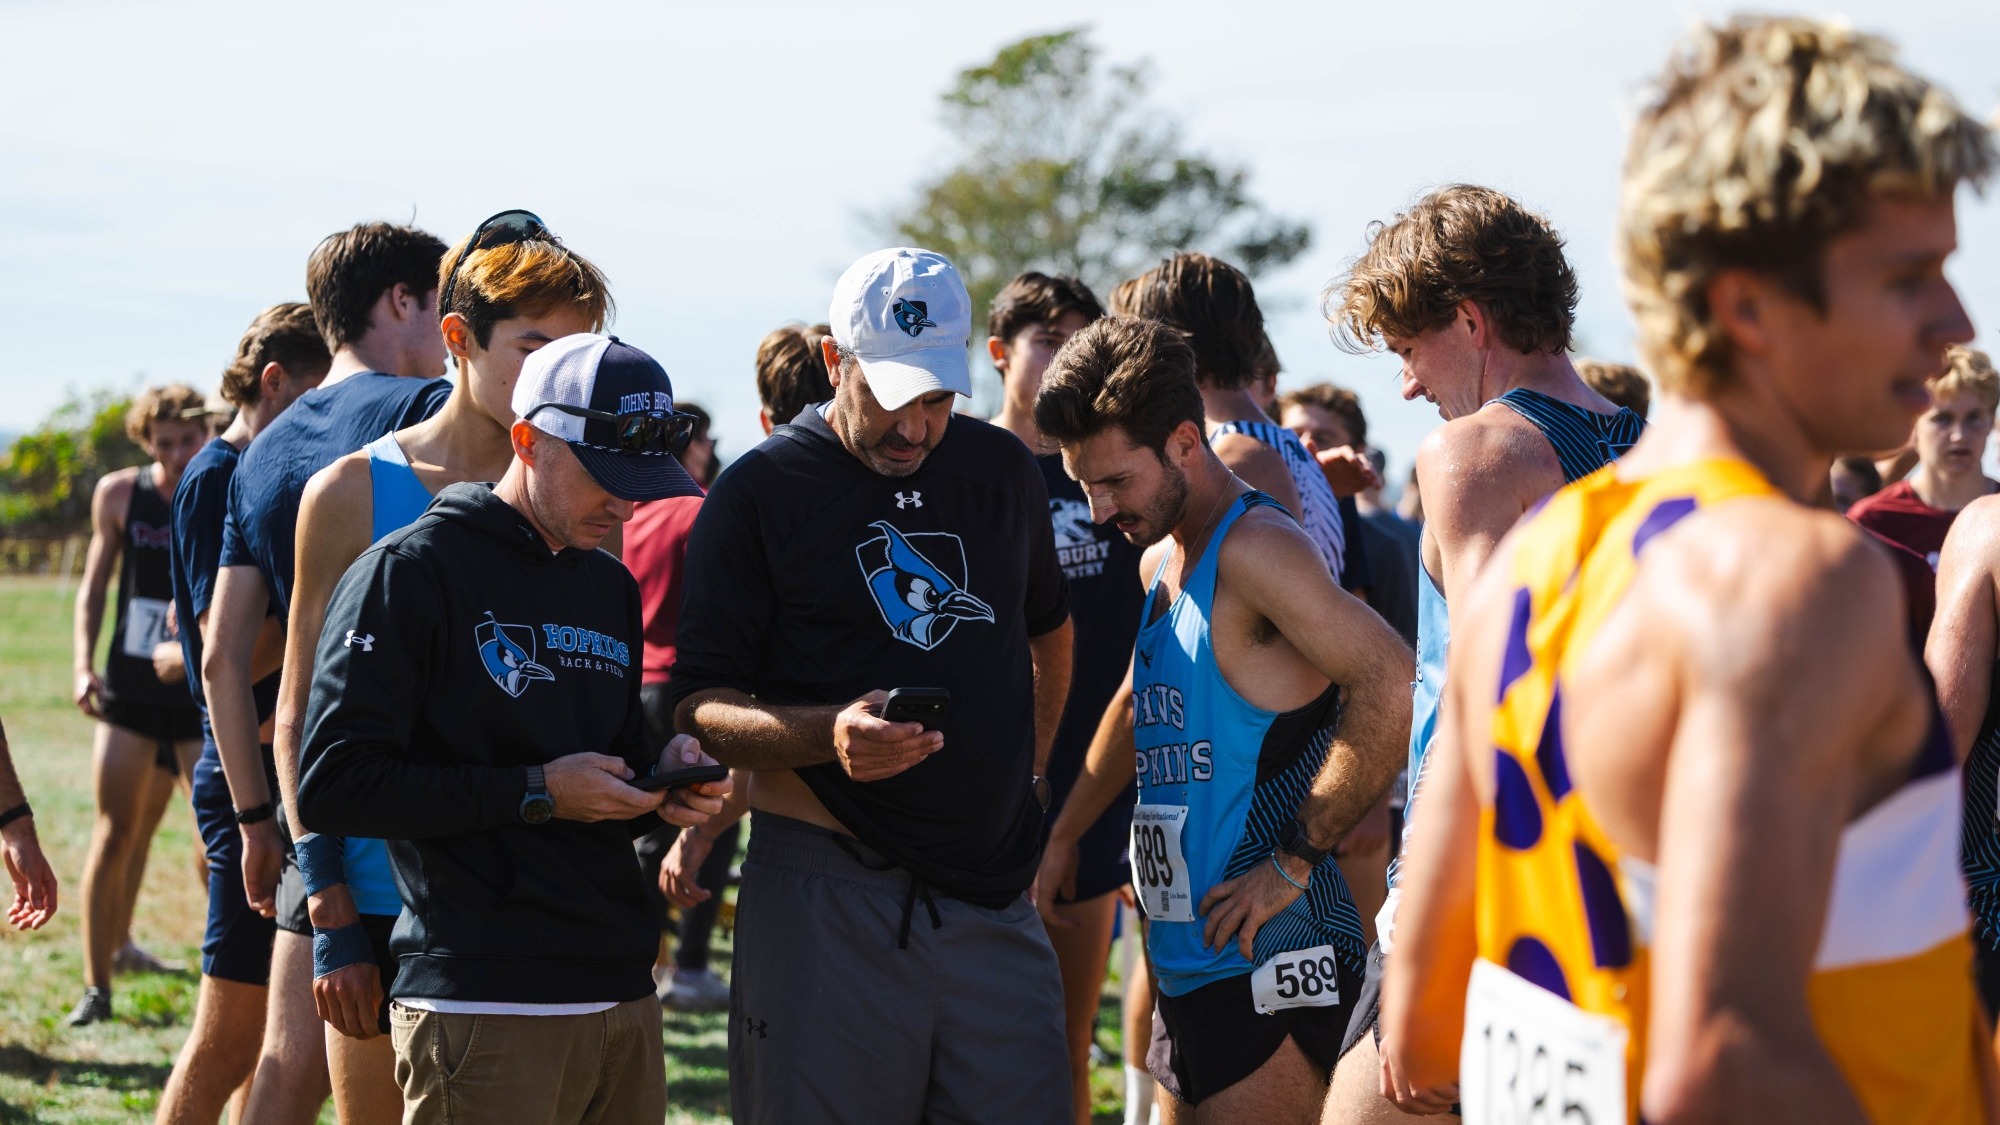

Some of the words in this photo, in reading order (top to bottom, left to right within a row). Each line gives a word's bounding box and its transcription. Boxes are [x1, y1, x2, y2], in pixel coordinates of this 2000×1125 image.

[618, 392, 651, 415] JOHNS
[1056, 541, 1110, 566] BURY
[542, 623, 631, 667] HOPKINS
[558, 654, 592, 669] RACK
[595, 660, 603, 671] &
[1135, 740, 1213, 788] PKINS
[1134, 824, 1173, 888] 589
[1275, 956, 1338, 998] 589
